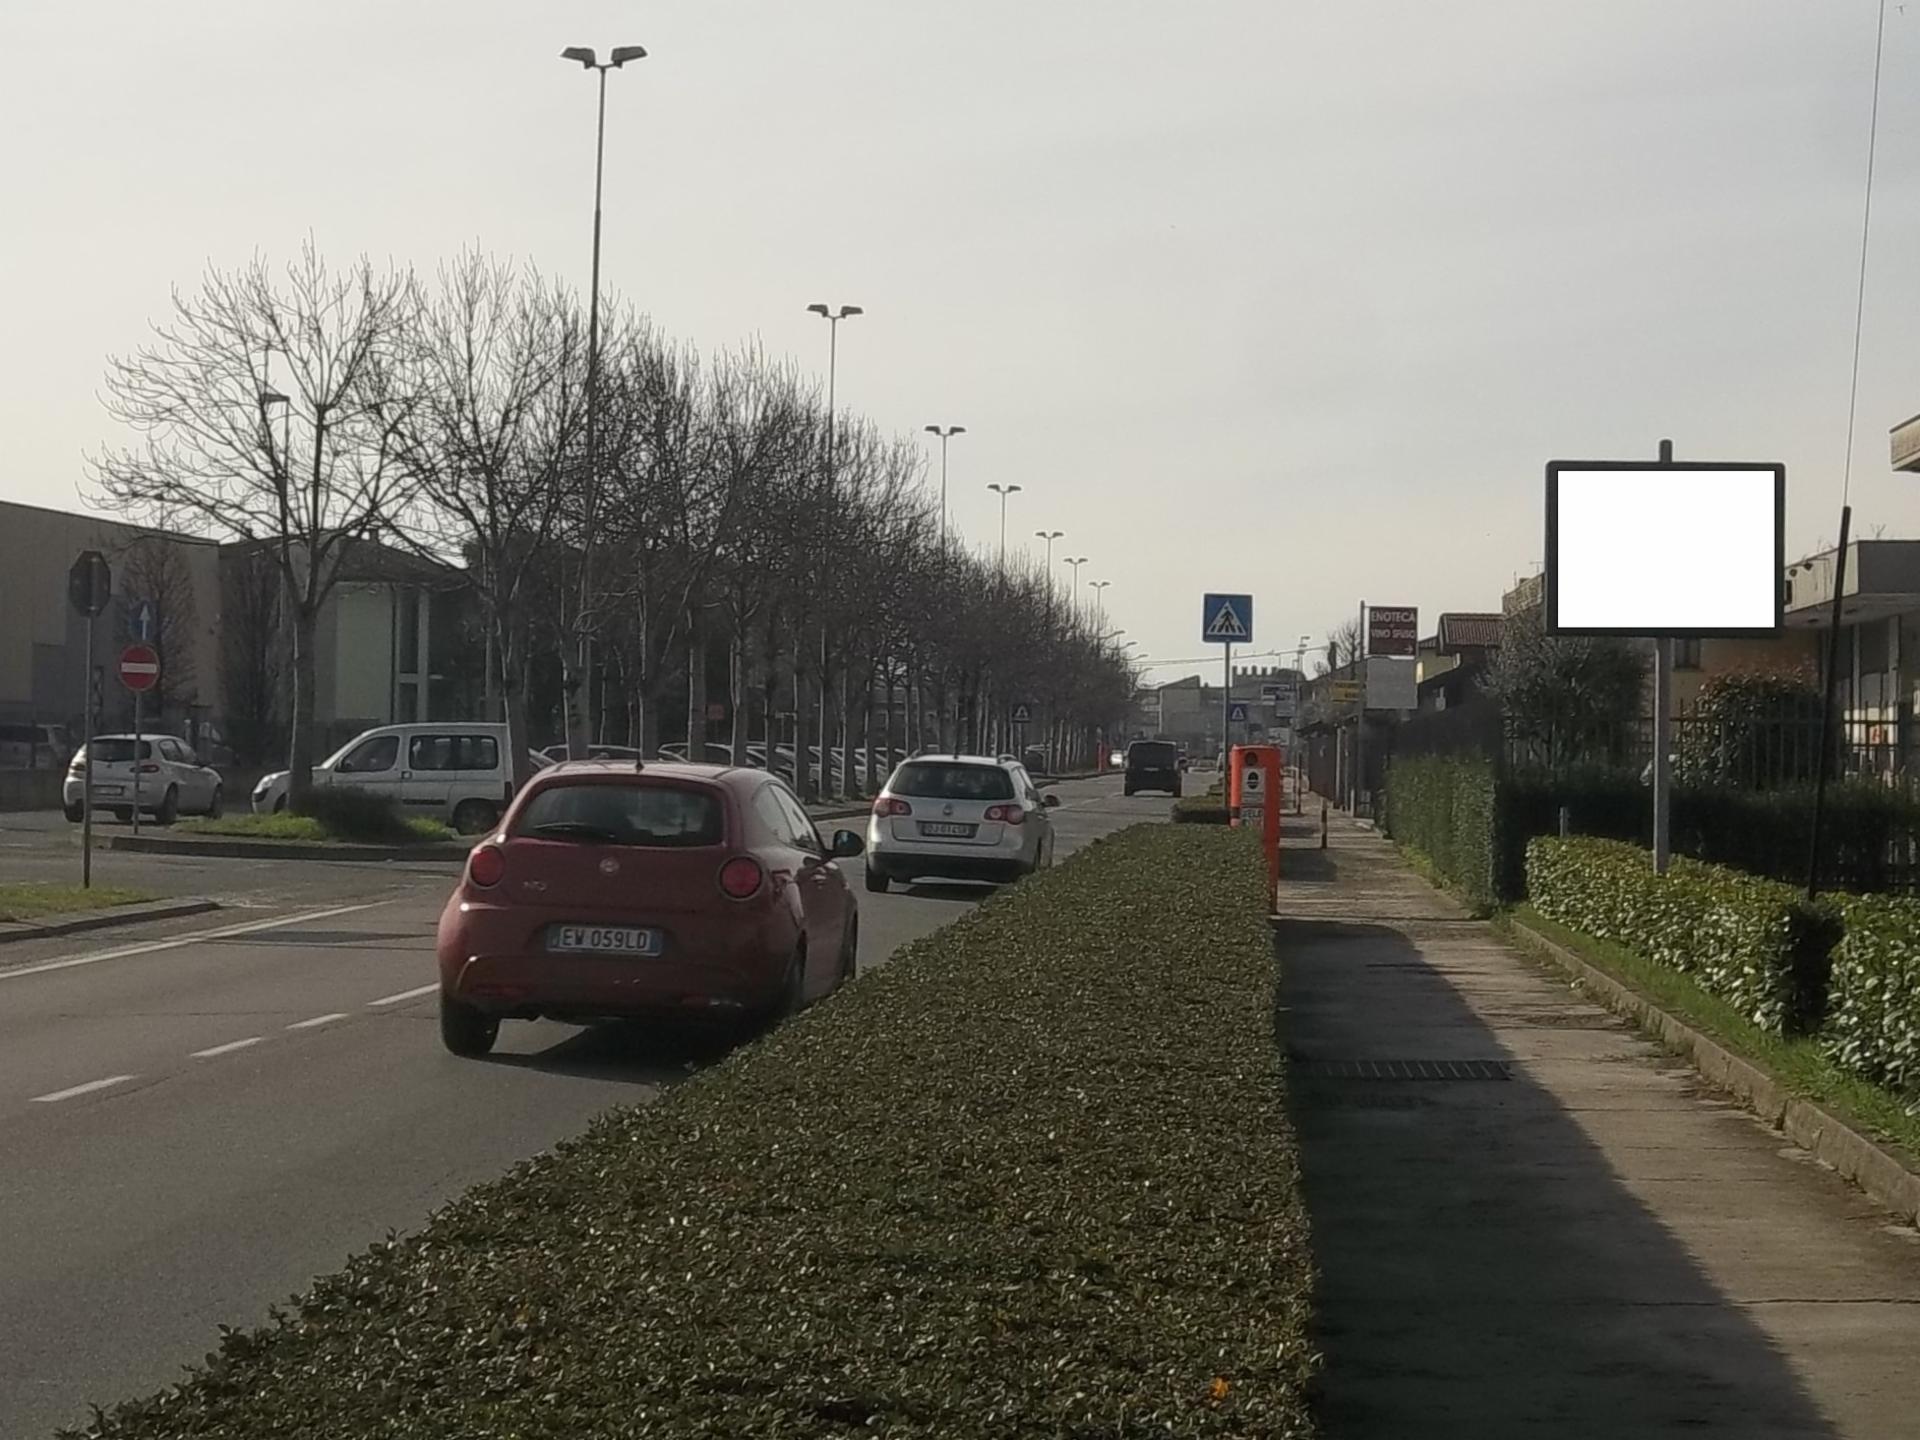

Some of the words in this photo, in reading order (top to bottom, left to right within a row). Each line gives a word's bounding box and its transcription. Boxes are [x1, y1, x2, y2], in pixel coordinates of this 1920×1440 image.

[1371, 610, 1416, 622] ENOTECA
[562, 928, 585, 946] EW
[591, 930, 648, 949] 059LD
